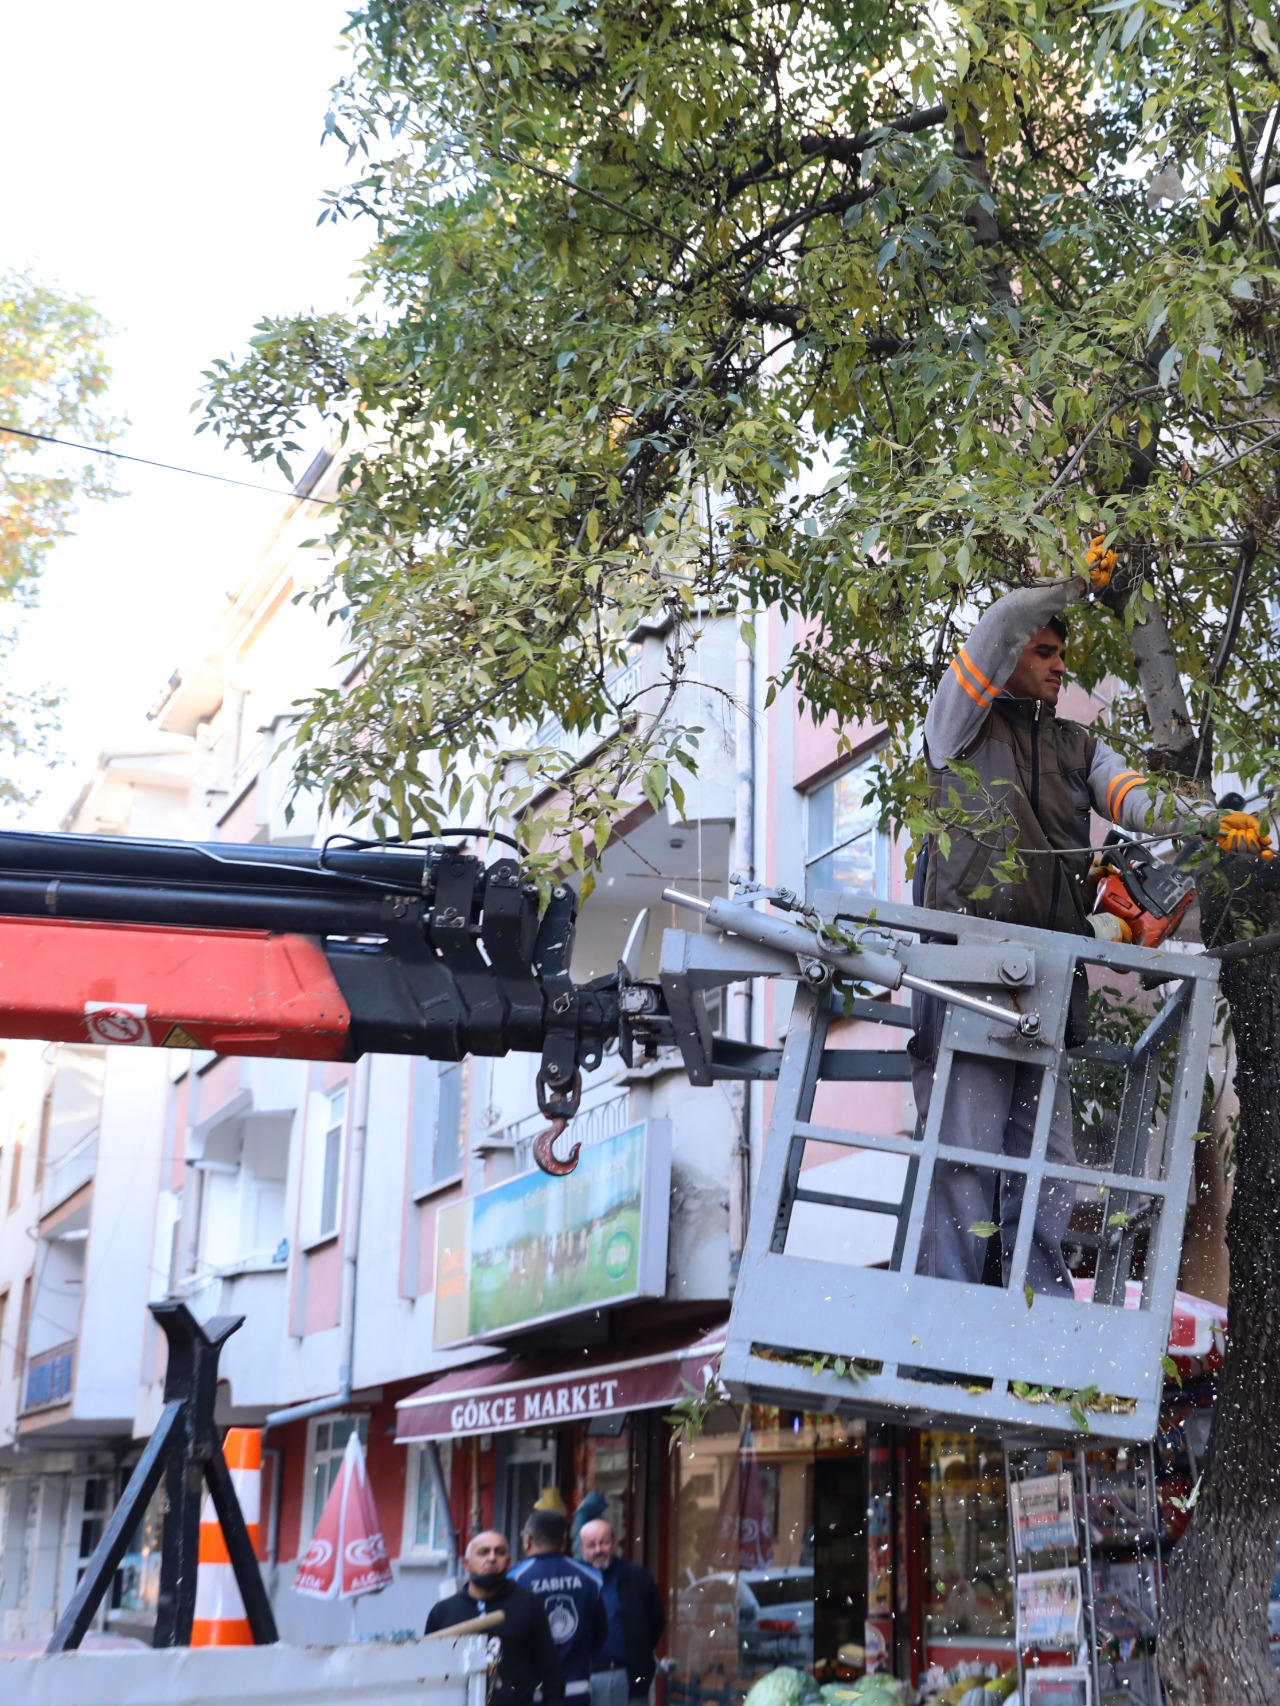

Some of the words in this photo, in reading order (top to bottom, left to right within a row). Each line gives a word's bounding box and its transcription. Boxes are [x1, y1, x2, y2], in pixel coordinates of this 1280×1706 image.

[451, 1396, 516, 1432] GÖKÇE
[523, 1379, 619, 1420] MARKET
[530, 1575, 582, 1595] ZABITA
